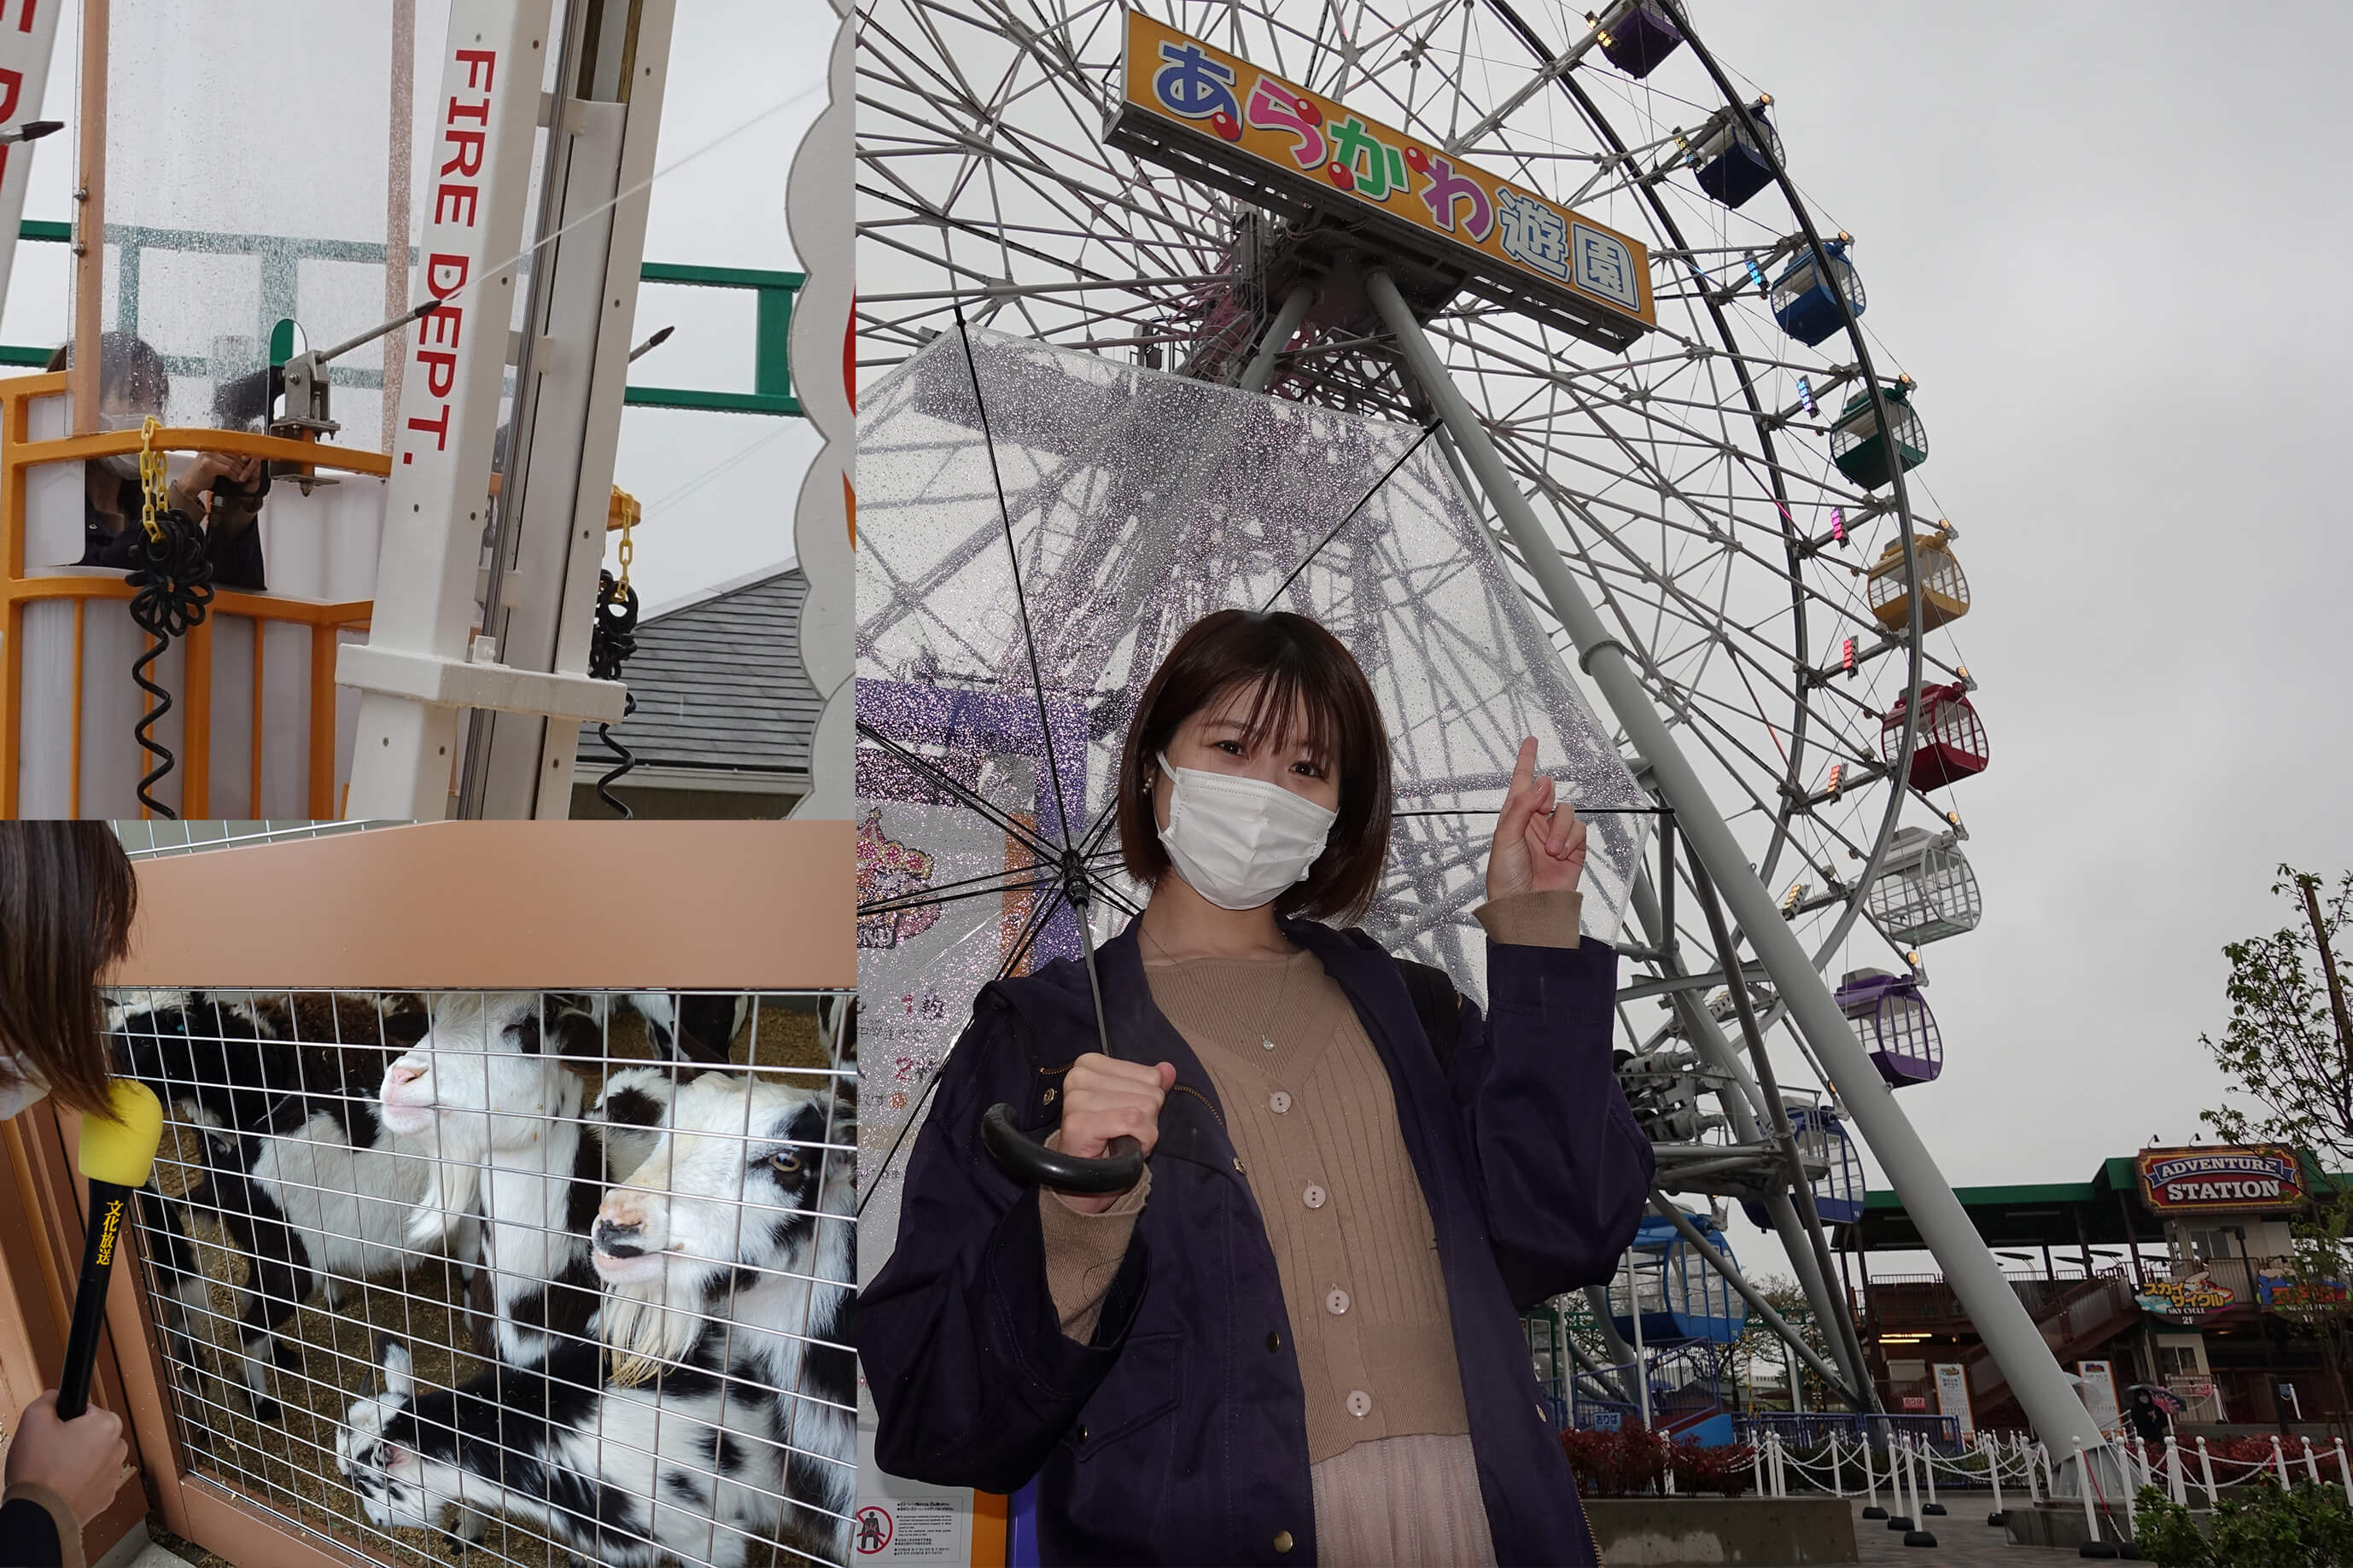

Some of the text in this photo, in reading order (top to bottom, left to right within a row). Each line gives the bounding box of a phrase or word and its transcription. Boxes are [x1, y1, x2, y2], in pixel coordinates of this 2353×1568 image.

[1153, 41, 1640, 312] あらかわ遊園
[403, 49, 497, 465] FIRE DEPT.
[2161, 1157, 2278, 1178] ADVENTURE
[2167, 1180, 2280, 1201] STATION
[96, 1199, 124, 1265] 文化放送
[2144, 1282, 2185, 1297] スカイ
[2171, 1293, 2225, 1308] サイクル
[2181, 1315, 2194, 1325] 2F
[1596, 1414, 1618, 1425] おりば
